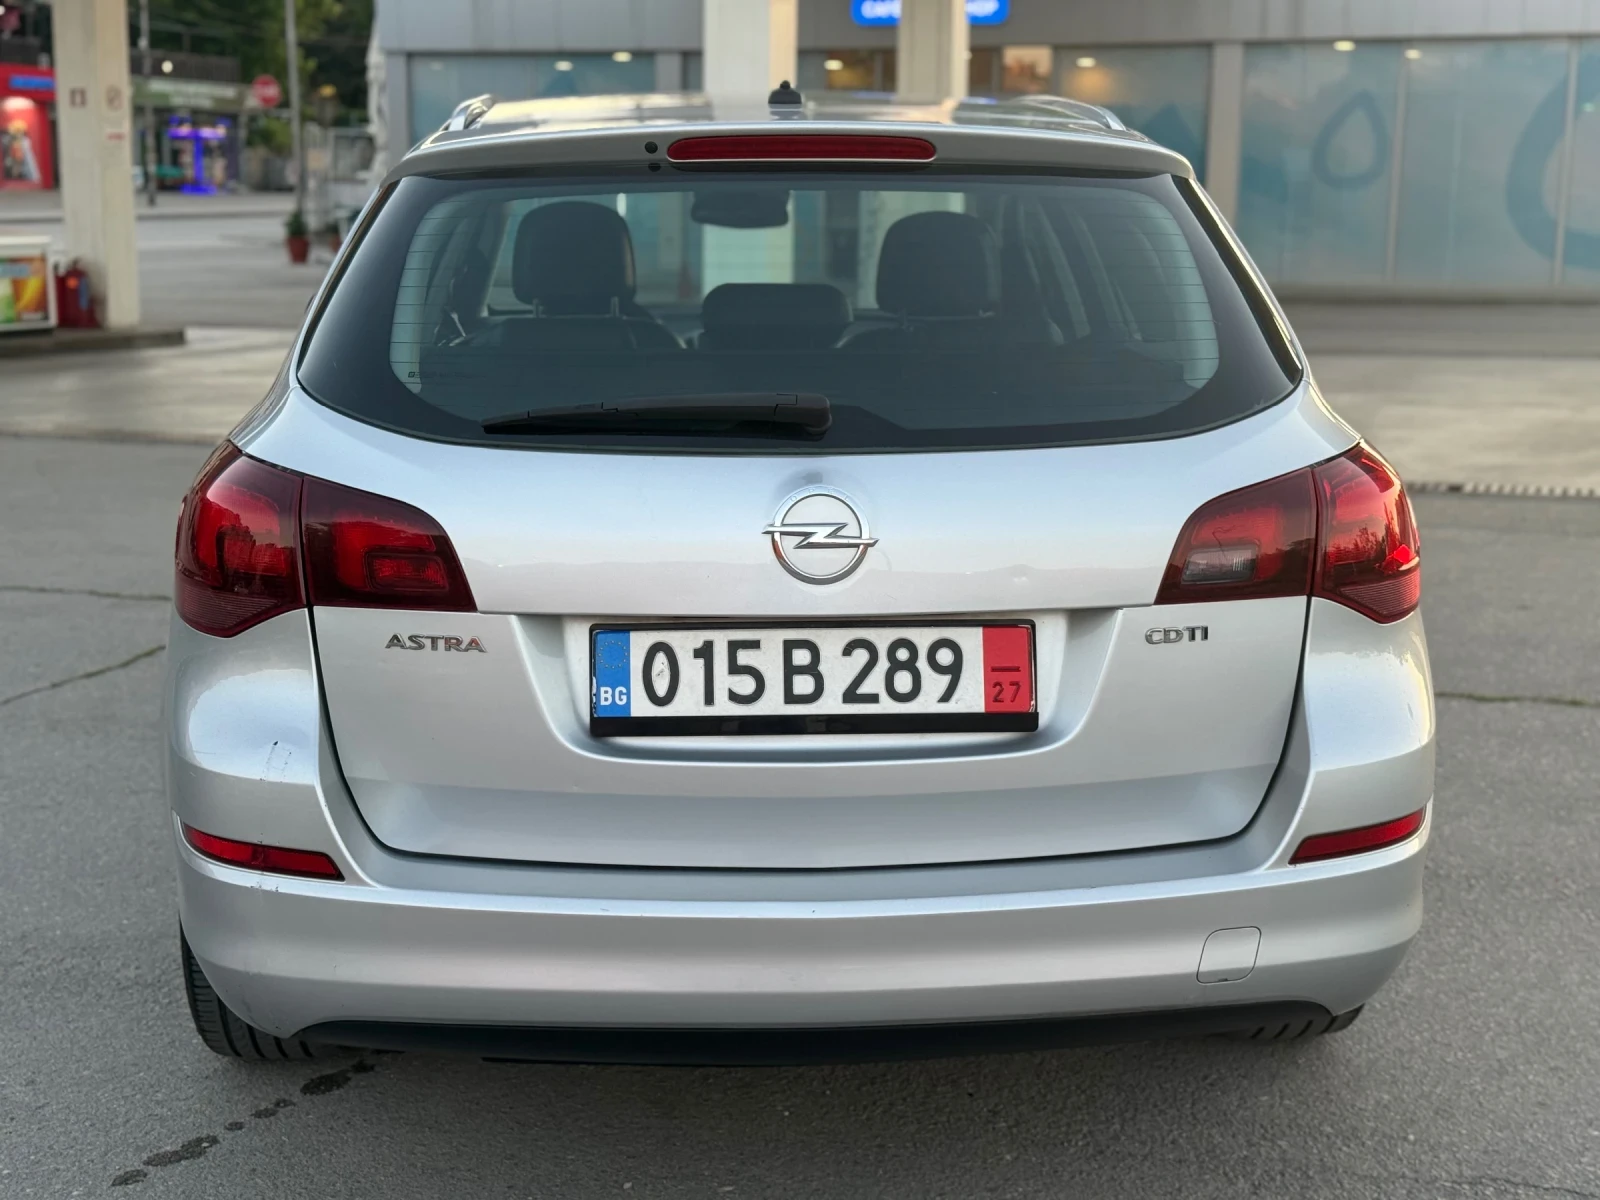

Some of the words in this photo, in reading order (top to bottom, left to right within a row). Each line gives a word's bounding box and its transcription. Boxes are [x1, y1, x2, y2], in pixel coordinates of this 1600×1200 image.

[385, 632, 488, 653] ASTRA
[1144, 625, 1209, 645] CDTI
[642, 639, 766, 707] 015
[783, 639, 825, 705] B
[841, 637, 964, 704] 289
[600, 686, 628, 706] BG
[992, 681, 1021, 703] 27
